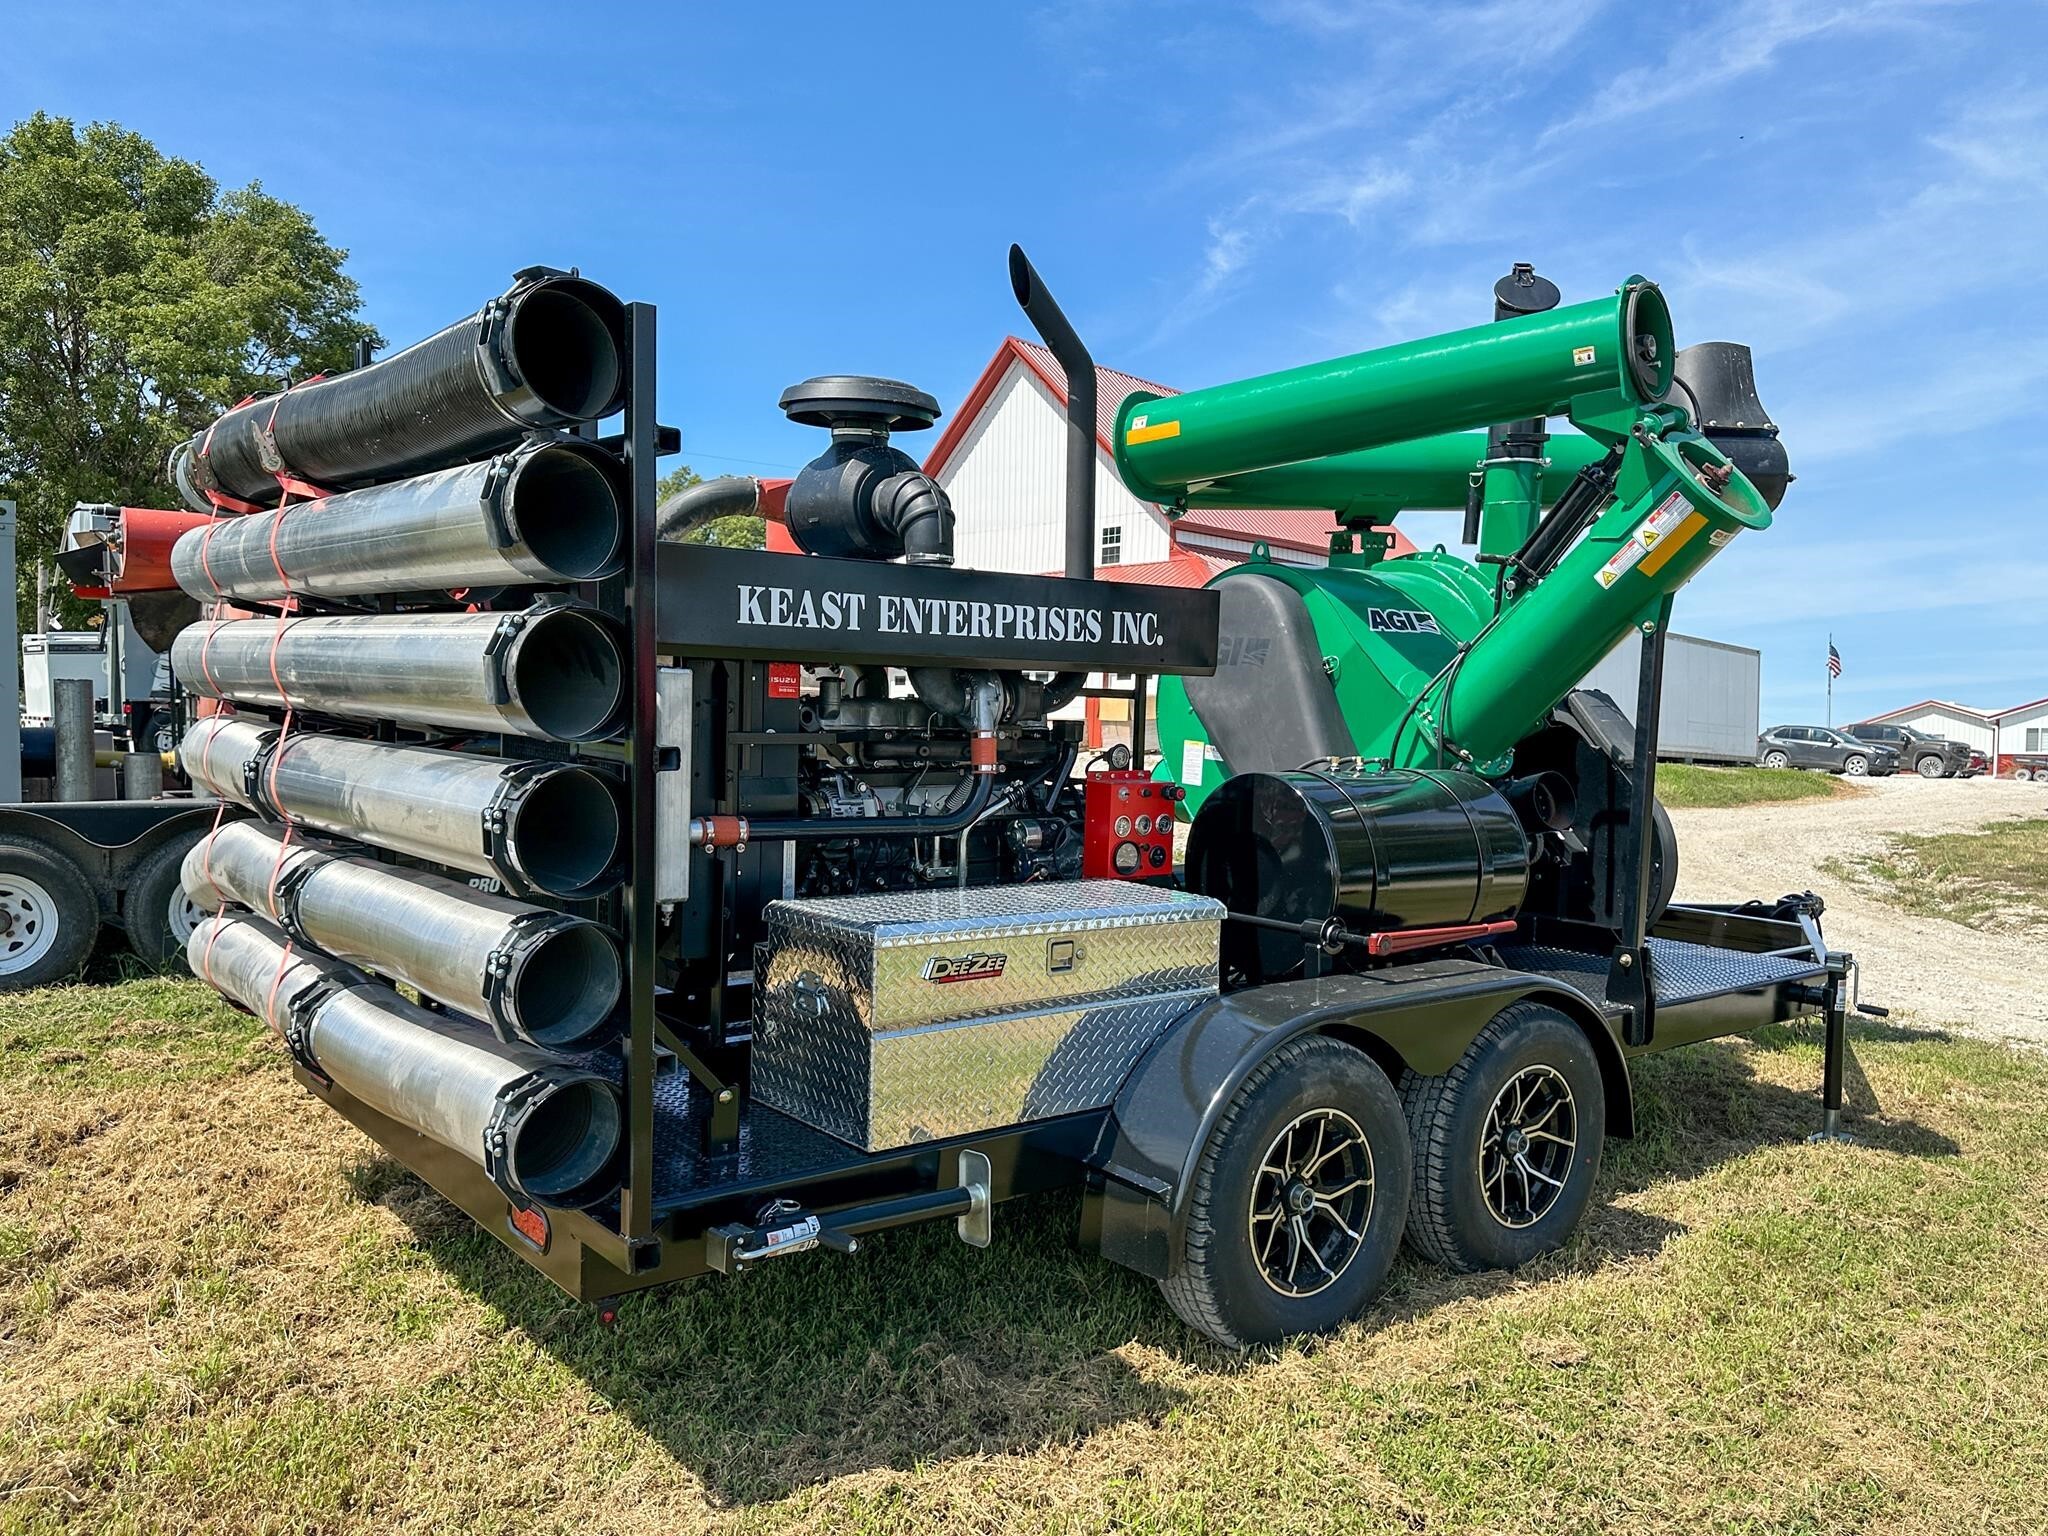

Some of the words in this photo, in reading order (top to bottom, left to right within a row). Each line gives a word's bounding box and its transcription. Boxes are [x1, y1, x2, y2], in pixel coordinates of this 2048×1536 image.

[737, 584, 866, 631] KEAST
[877, 595, 1102, 644] ENTERPRISES
[1111, 611, 1164, 646] INC.
[1368, 608, 1420, 633] AGI
[770, 676, 797, 684] ISUZU
